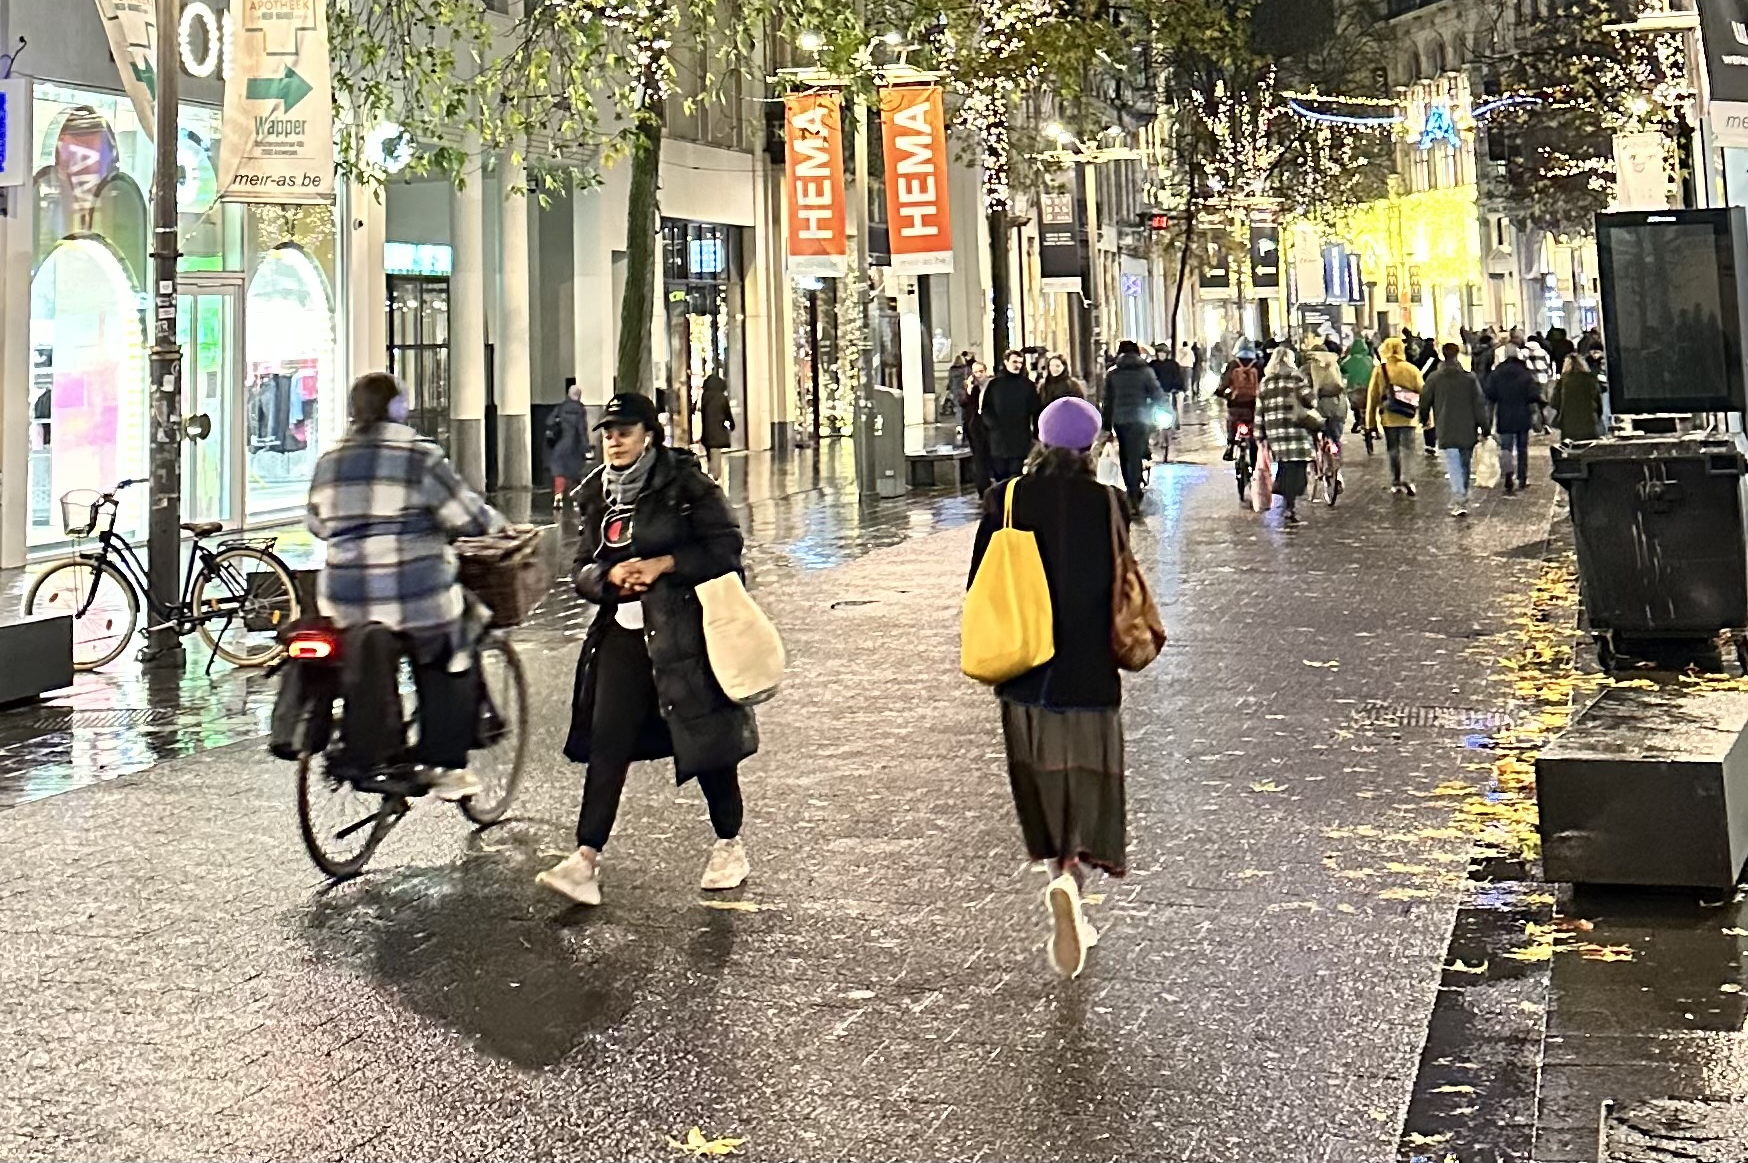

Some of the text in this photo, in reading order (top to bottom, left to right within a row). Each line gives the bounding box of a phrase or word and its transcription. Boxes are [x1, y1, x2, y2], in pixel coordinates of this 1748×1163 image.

[249, 0, 310, 11] APOTHEEK
[254, 115, 307, 138] Wapper
[232, 172, 321, 187] meir-as.be
[791, 106, 833, 239] HEMA
[893, 101, 939, 237] HEMA
